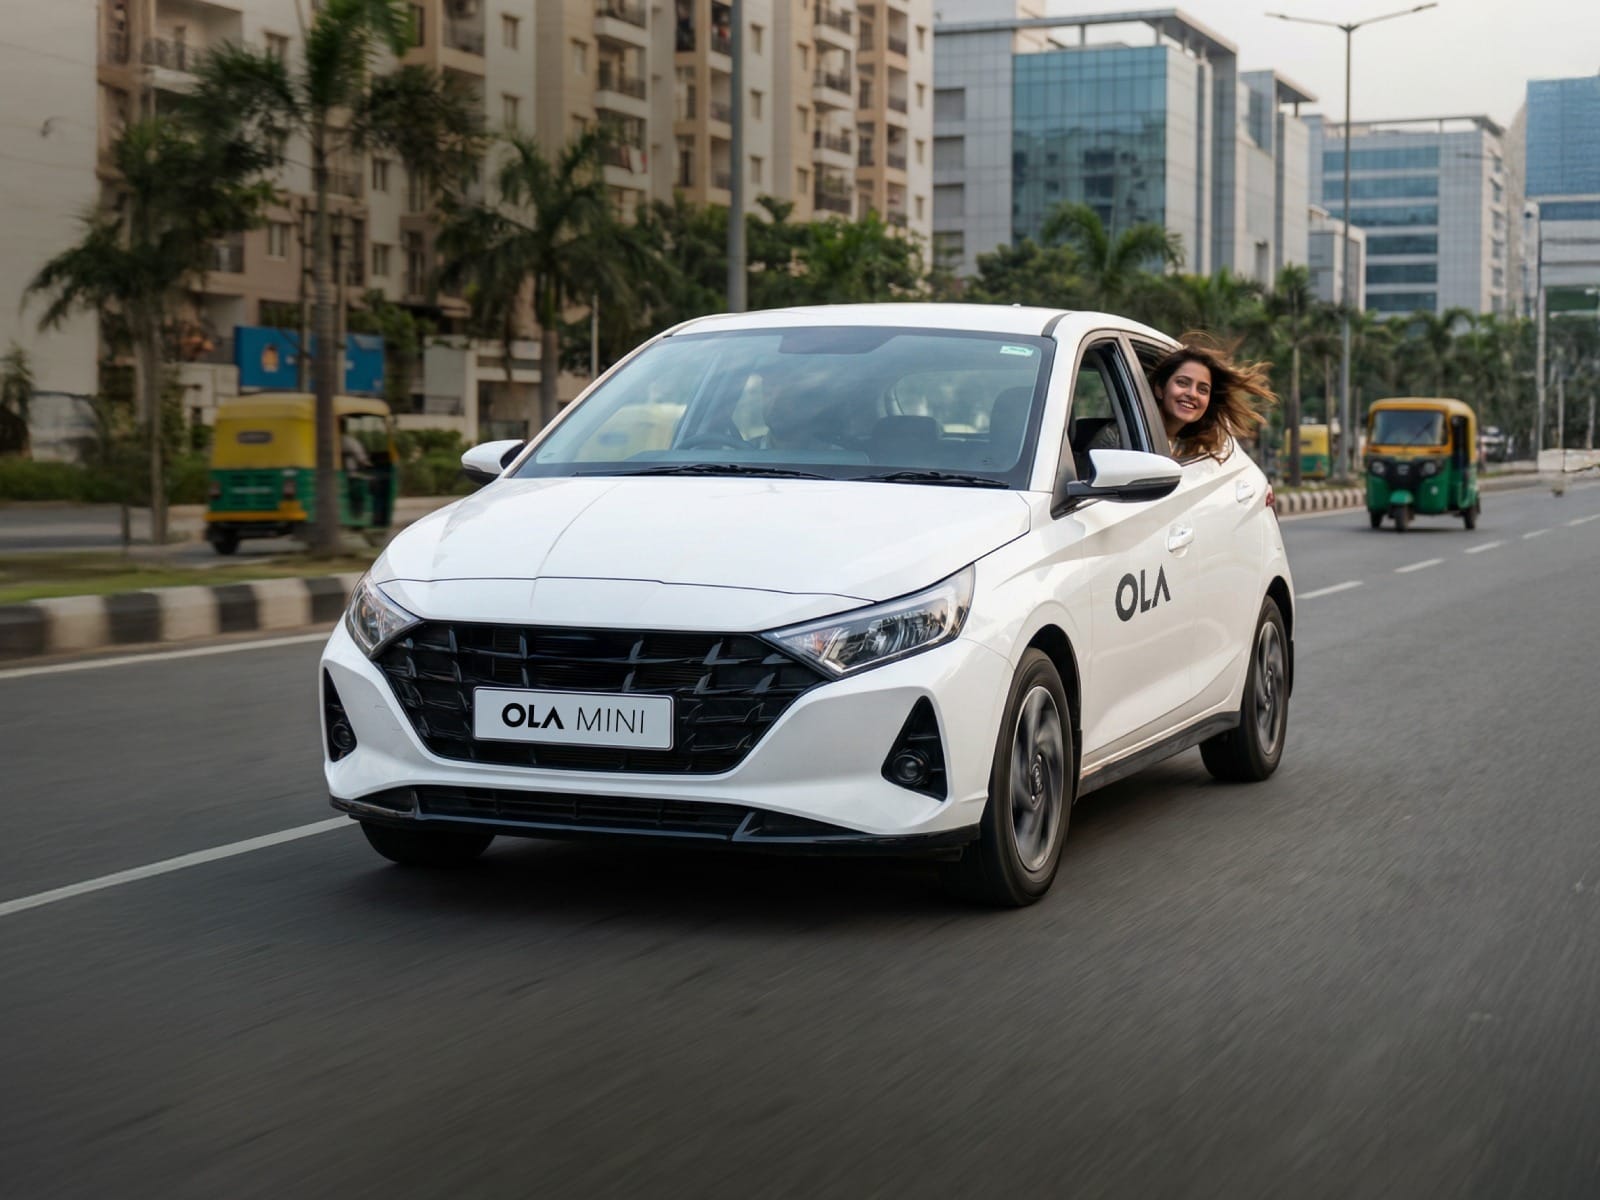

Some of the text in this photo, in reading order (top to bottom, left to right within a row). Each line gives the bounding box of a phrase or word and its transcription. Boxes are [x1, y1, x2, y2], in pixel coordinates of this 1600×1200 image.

[1115, 563, 1171, 622] OLA
[501, 702, 645, 734] OLA MINI
